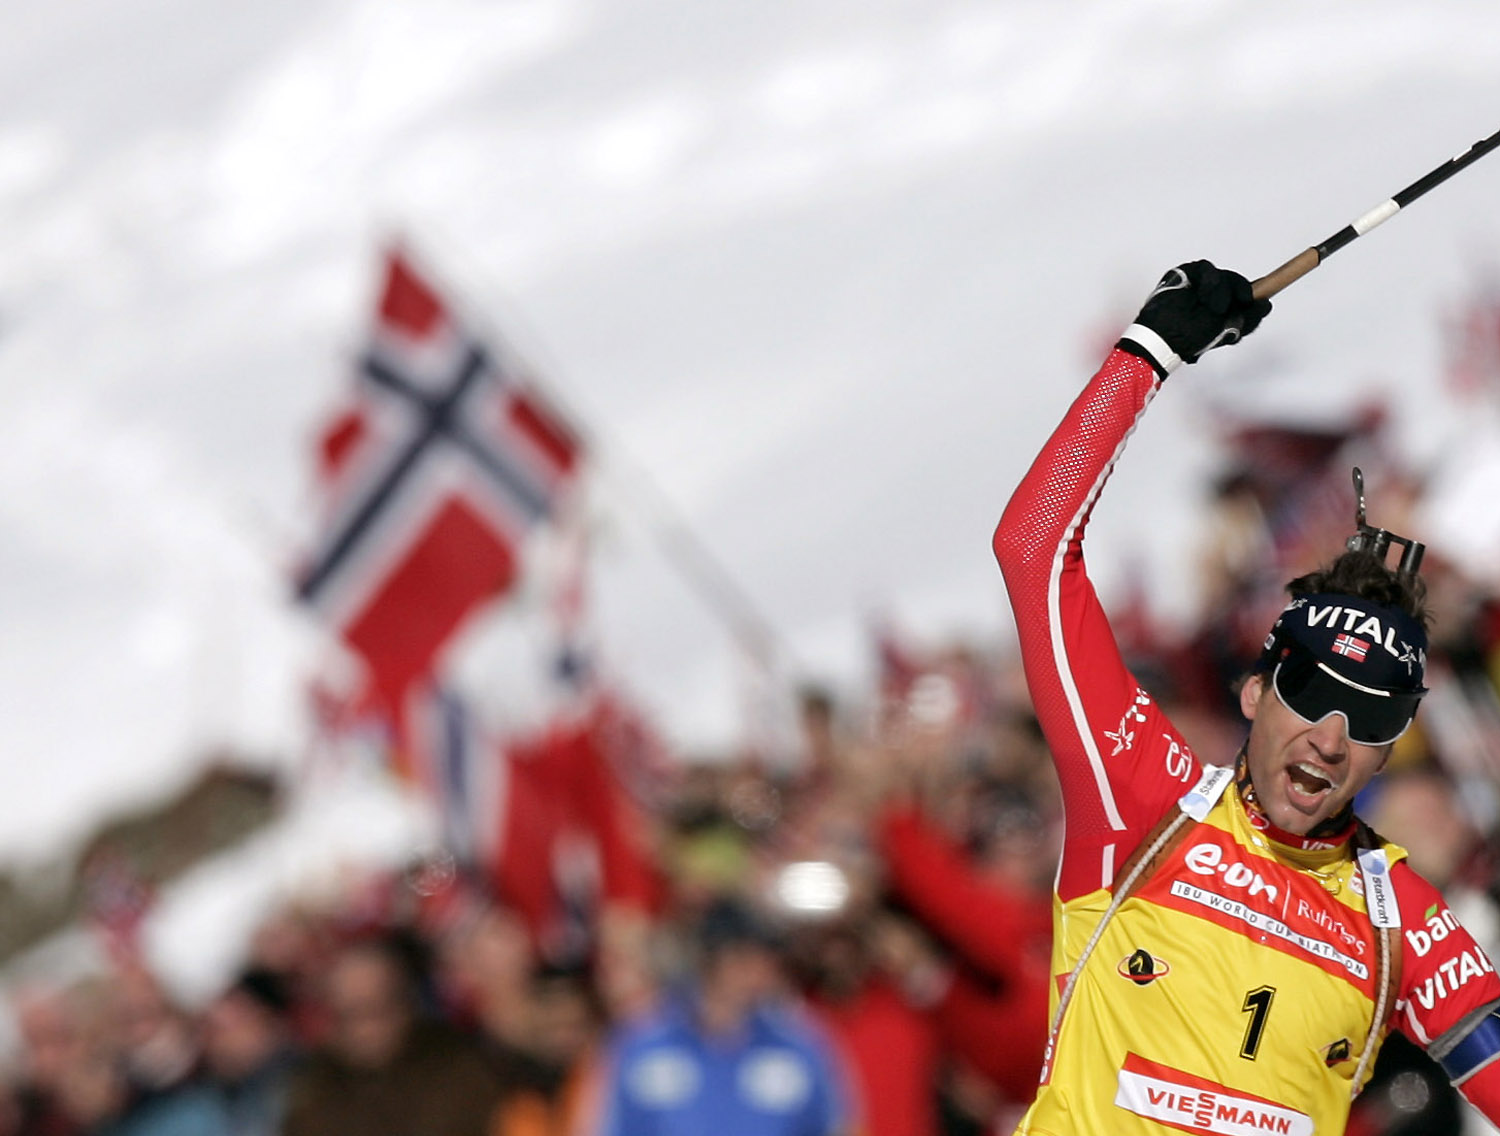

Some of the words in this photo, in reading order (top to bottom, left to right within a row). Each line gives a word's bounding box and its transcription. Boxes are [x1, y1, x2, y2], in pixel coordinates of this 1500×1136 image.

[1307, 605, 1400, 658] VITAL
[1177, 884, 1203, 899] IBU
[1208, 895, 1259, 925] WORLD
[1240, 985, 1277, 1061] 1
[1147, 1086, 1293, 1136] VIESSMANN
